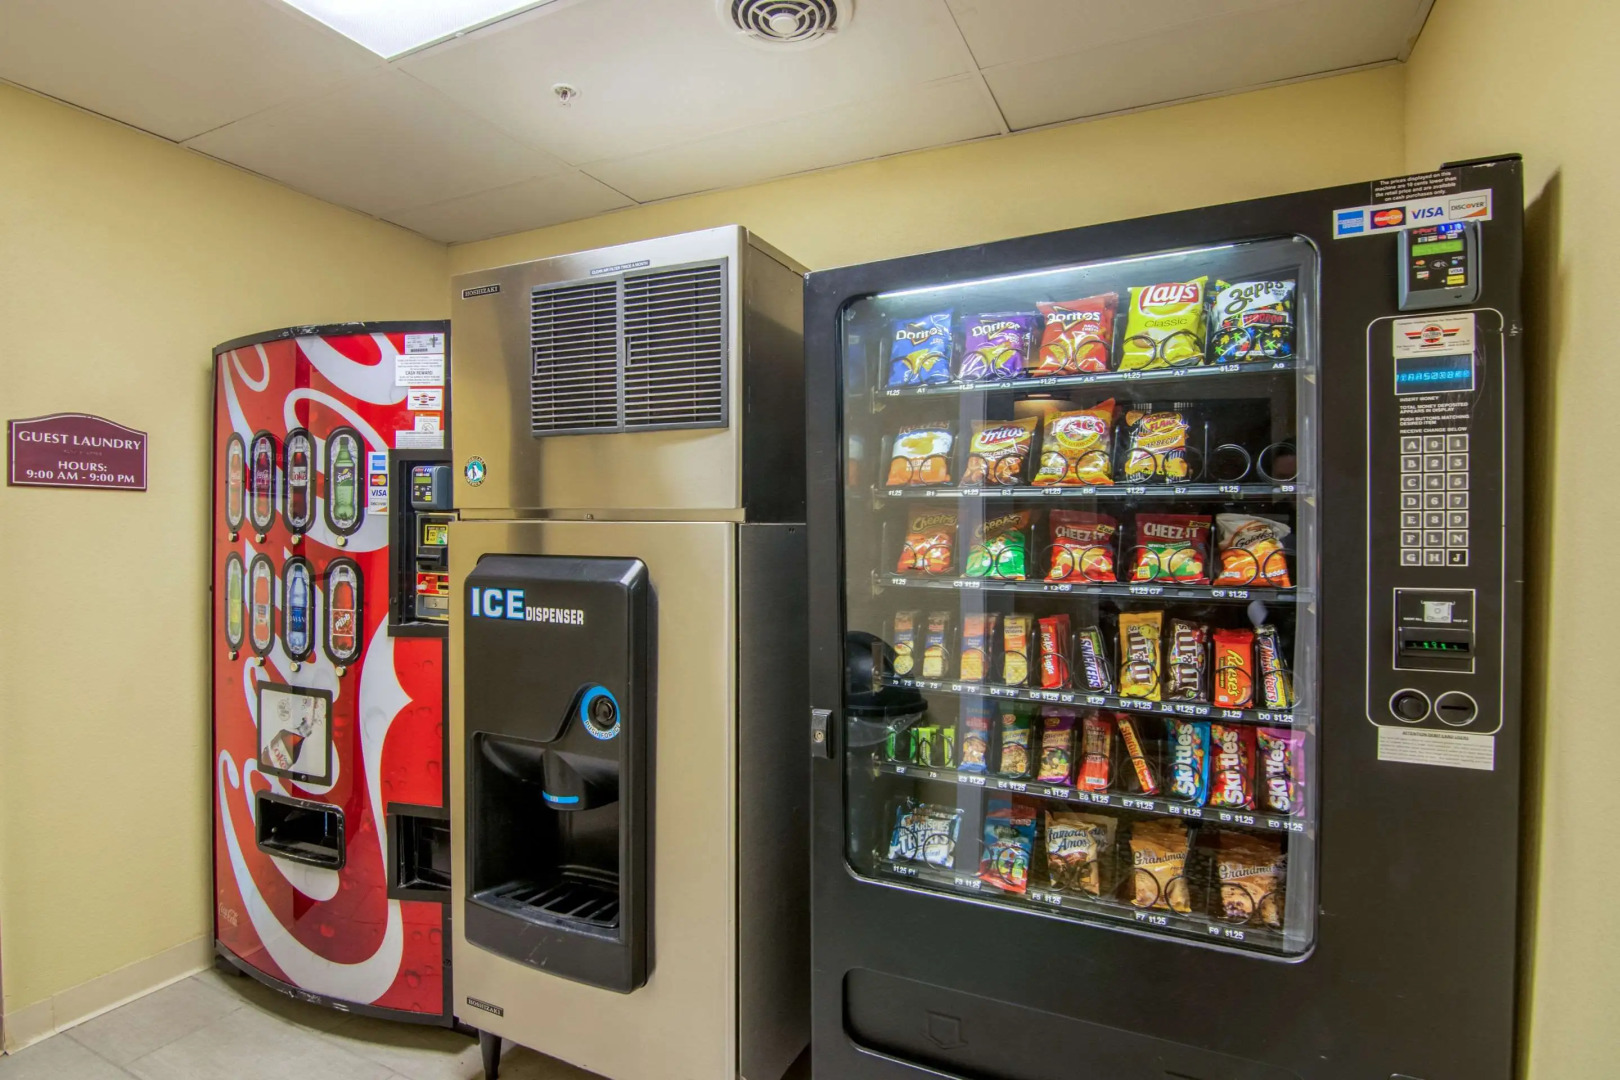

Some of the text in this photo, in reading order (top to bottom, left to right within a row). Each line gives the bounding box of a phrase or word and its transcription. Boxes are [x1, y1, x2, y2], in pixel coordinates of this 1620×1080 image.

[1407, 174, 1432, 183] displayed
[1405, 192, 1433, 200] purchases
[1451, 201, 1484, 211] DISCOVER
[1411, 206, 1444, 220] VISA
[465, 286, 498, 297] HOSHIZAKI
[1143, 283, 1196, 306] Lay's
[1047, 311, 1100, 323] Doritos
[1144, 317, 1188, 328] Classic
[896, 327, 943, 340] Doritos
[972, 320, 1020, 337] Doritos
[1220, 364, 1240, 372] $1.25
[983, 425, 1025, 443] Fritos
[18, 430, 141, 450] GUEST LAUNDRY
[1407, 441, 1417, 450] A
[58, 460, 107, 472] HOURS:
[1407, 459, 1417, 468] B
[1431, 459, 1439, 467] 2
[1454, 458, 1462, 466] 3
[26, 469, 53, 479] 9:00
[57, 472, 78, 480] AM
[89, 473, 114, 482] 9:00
[117, 474, 135, 483] PM
[1407, 478, 1416, 487] C
[1431, 478, 1438, 486] 4
[1454, 477, 1462, 486] 5
[1407, 497, 1416, 506] D
[1431, 497, 1439, 505] 6
[1454, 497, 1462, 505] 7
[912, 514, 956, 532] Cheetos
[1407, 516, 1416, 524] E
[1431, 516, 1439, 524] 8
[1454, 515, 1462, 524] 9
[1055, 525, 1105, 541] CHEEZ-IT
[1143, 522, 1199, 539] CHEEZ-IT
[1407, 534, 1416, 543] F
[1430, 534, 1438, 543] L
[1453, 534, 1463, 543] N
[1406, 553, 1416, 562] G
[1430, 553, 1440, 562] H
[1453, 553, 1461, 562] J
[471, 587, 584, 625] ICE DISPENSER
[335, 613, 351, 631] Pibb
[1080, 638, 1100, 688] SNICKERS
[1226, 649, 1244, 696] Reese's
[1087, 696, 1105, 704] $1.25
[1120, 700, 1152, 710] D7 $1.25
[1176, 705, 1194, 714] $1.25
[1196, 706, 1208, 715] D9
[1222, 710, 1242, 718] $1.25
[1259, 712, 1294, 722] D0 $1.25
[584, 720, 599, 737] PUSH
[998, 781, 1026, 791] E4 $1.25
[1052, 789, 1070, 798] $1.25
[1091, 795, 1109, 804] $1.25
[1123, 799, 1154, 810] E7 $1.25
[1169, 806, 1202, 817] E8 $1.25
[1220, 812, 1254, 825] E9 $1.25
[915, 820, 949, 831] KRISPIES
[1268, 820, 1303, 832] E0 $1.25
[899, 833, 949, 854] TREATS
[1055, 838, 1089, 853] Amos
[893, 866, 907, 875] $1.25
[1032, 892, 1061, 905] F5 $1.25
[1136, 912, 1166, 926] F7 $1.25
[1208, 926, 1244, 940] F9 $1.25
